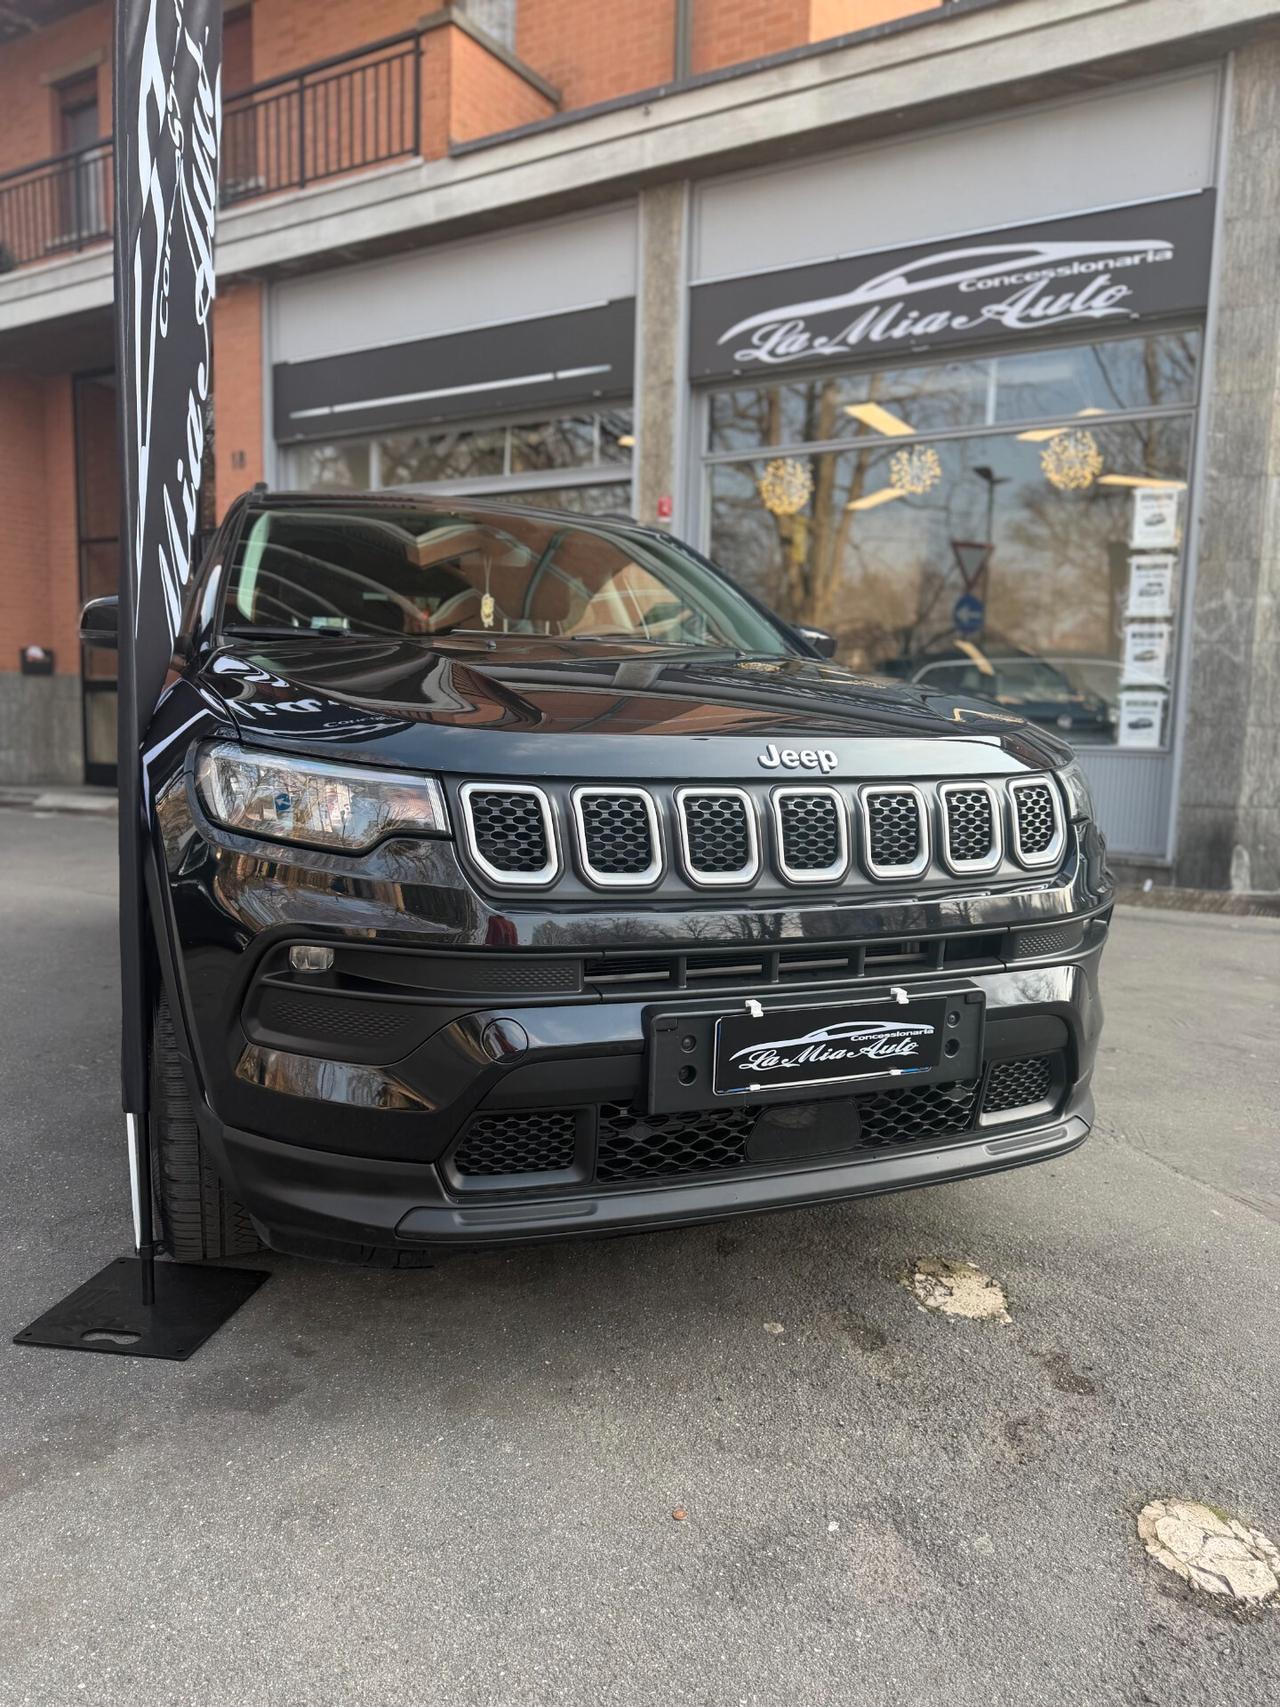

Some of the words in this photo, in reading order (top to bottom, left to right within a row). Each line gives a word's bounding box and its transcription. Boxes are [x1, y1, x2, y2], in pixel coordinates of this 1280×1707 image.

[958, 248, 1174, 293] Concessionaria
[734, 318, 816, 363] La
[812, 301, 951, 350] Mia
[951, 273, 1133, 330] Auto
[757, 744, 839, 774] Jeep
[850, 1028, 934, 1042] Concessionaria
[739, 1049, 781, 1071] La
[781, 1043, 847, 1067] Mia
[846, 1037, 919, 1059] Auto
